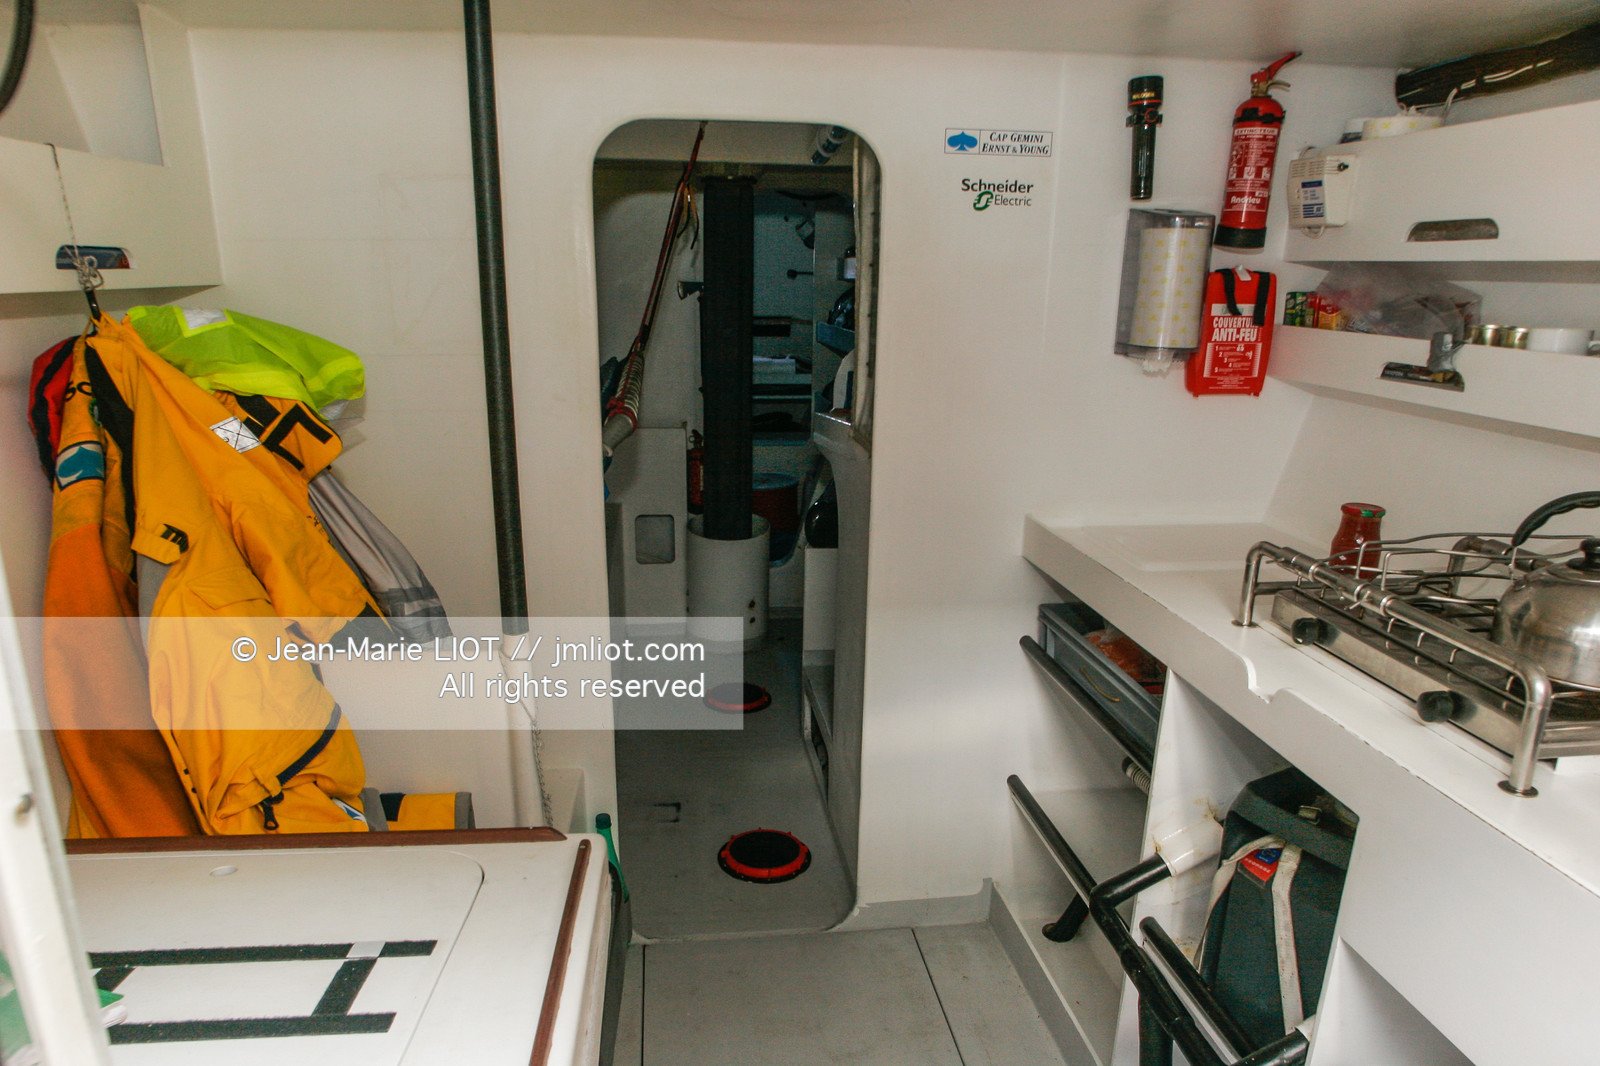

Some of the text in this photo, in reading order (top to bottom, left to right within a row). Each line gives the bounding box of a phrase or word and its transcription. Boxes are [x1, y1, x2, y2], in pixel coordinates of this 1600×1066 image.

[989, 131, 1045, 143] CAP GEMINI
[981, 142, 1011, 154] ERNST
[1019, 145, 1049, 155] YOUNG
[961, 178, 1034, 193] Schneider
[994, 194, 1032, 206] Electric
[1211, 328, 1258, 342] ANTI-FEU
